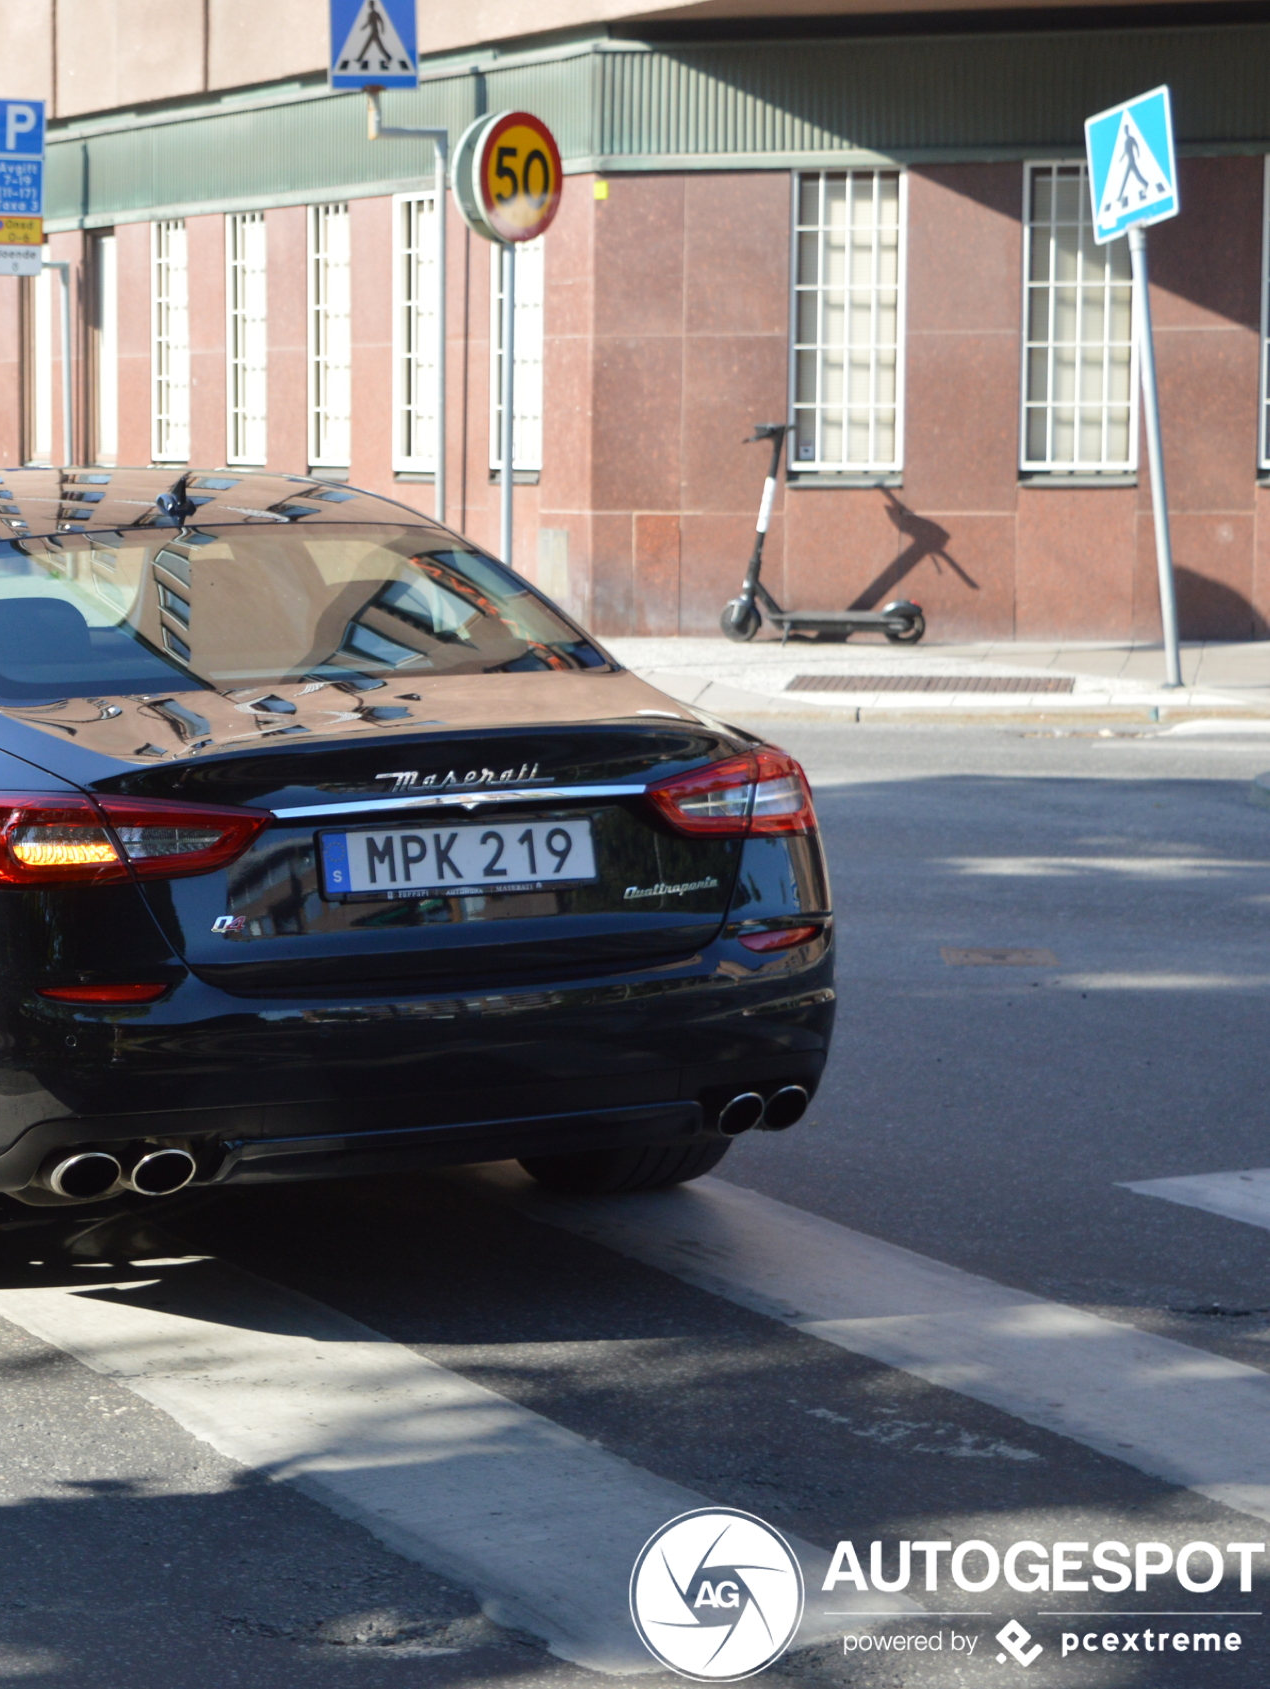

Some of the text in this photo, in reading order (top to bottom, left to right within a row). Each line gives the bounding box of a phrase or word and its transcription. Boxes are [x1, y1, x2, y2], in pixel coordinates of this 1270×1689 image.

[5, 104, 37, 150] P
[3, 174, 32, 186] 7-19
[495, 146, 550, 210] 50
[31, 200, 39, 212] 3
[5, 219, 34, 230] Onsd
[375, 763, 555, 792] Maserati
[366, 827, 573, 884] MPK 219
[332, 870, 343, 883] S
[397, 888, 429, 899] Ferrari
[495, 883, 533, 893] MASERATI
[211, 915, 246, 933] Q4
